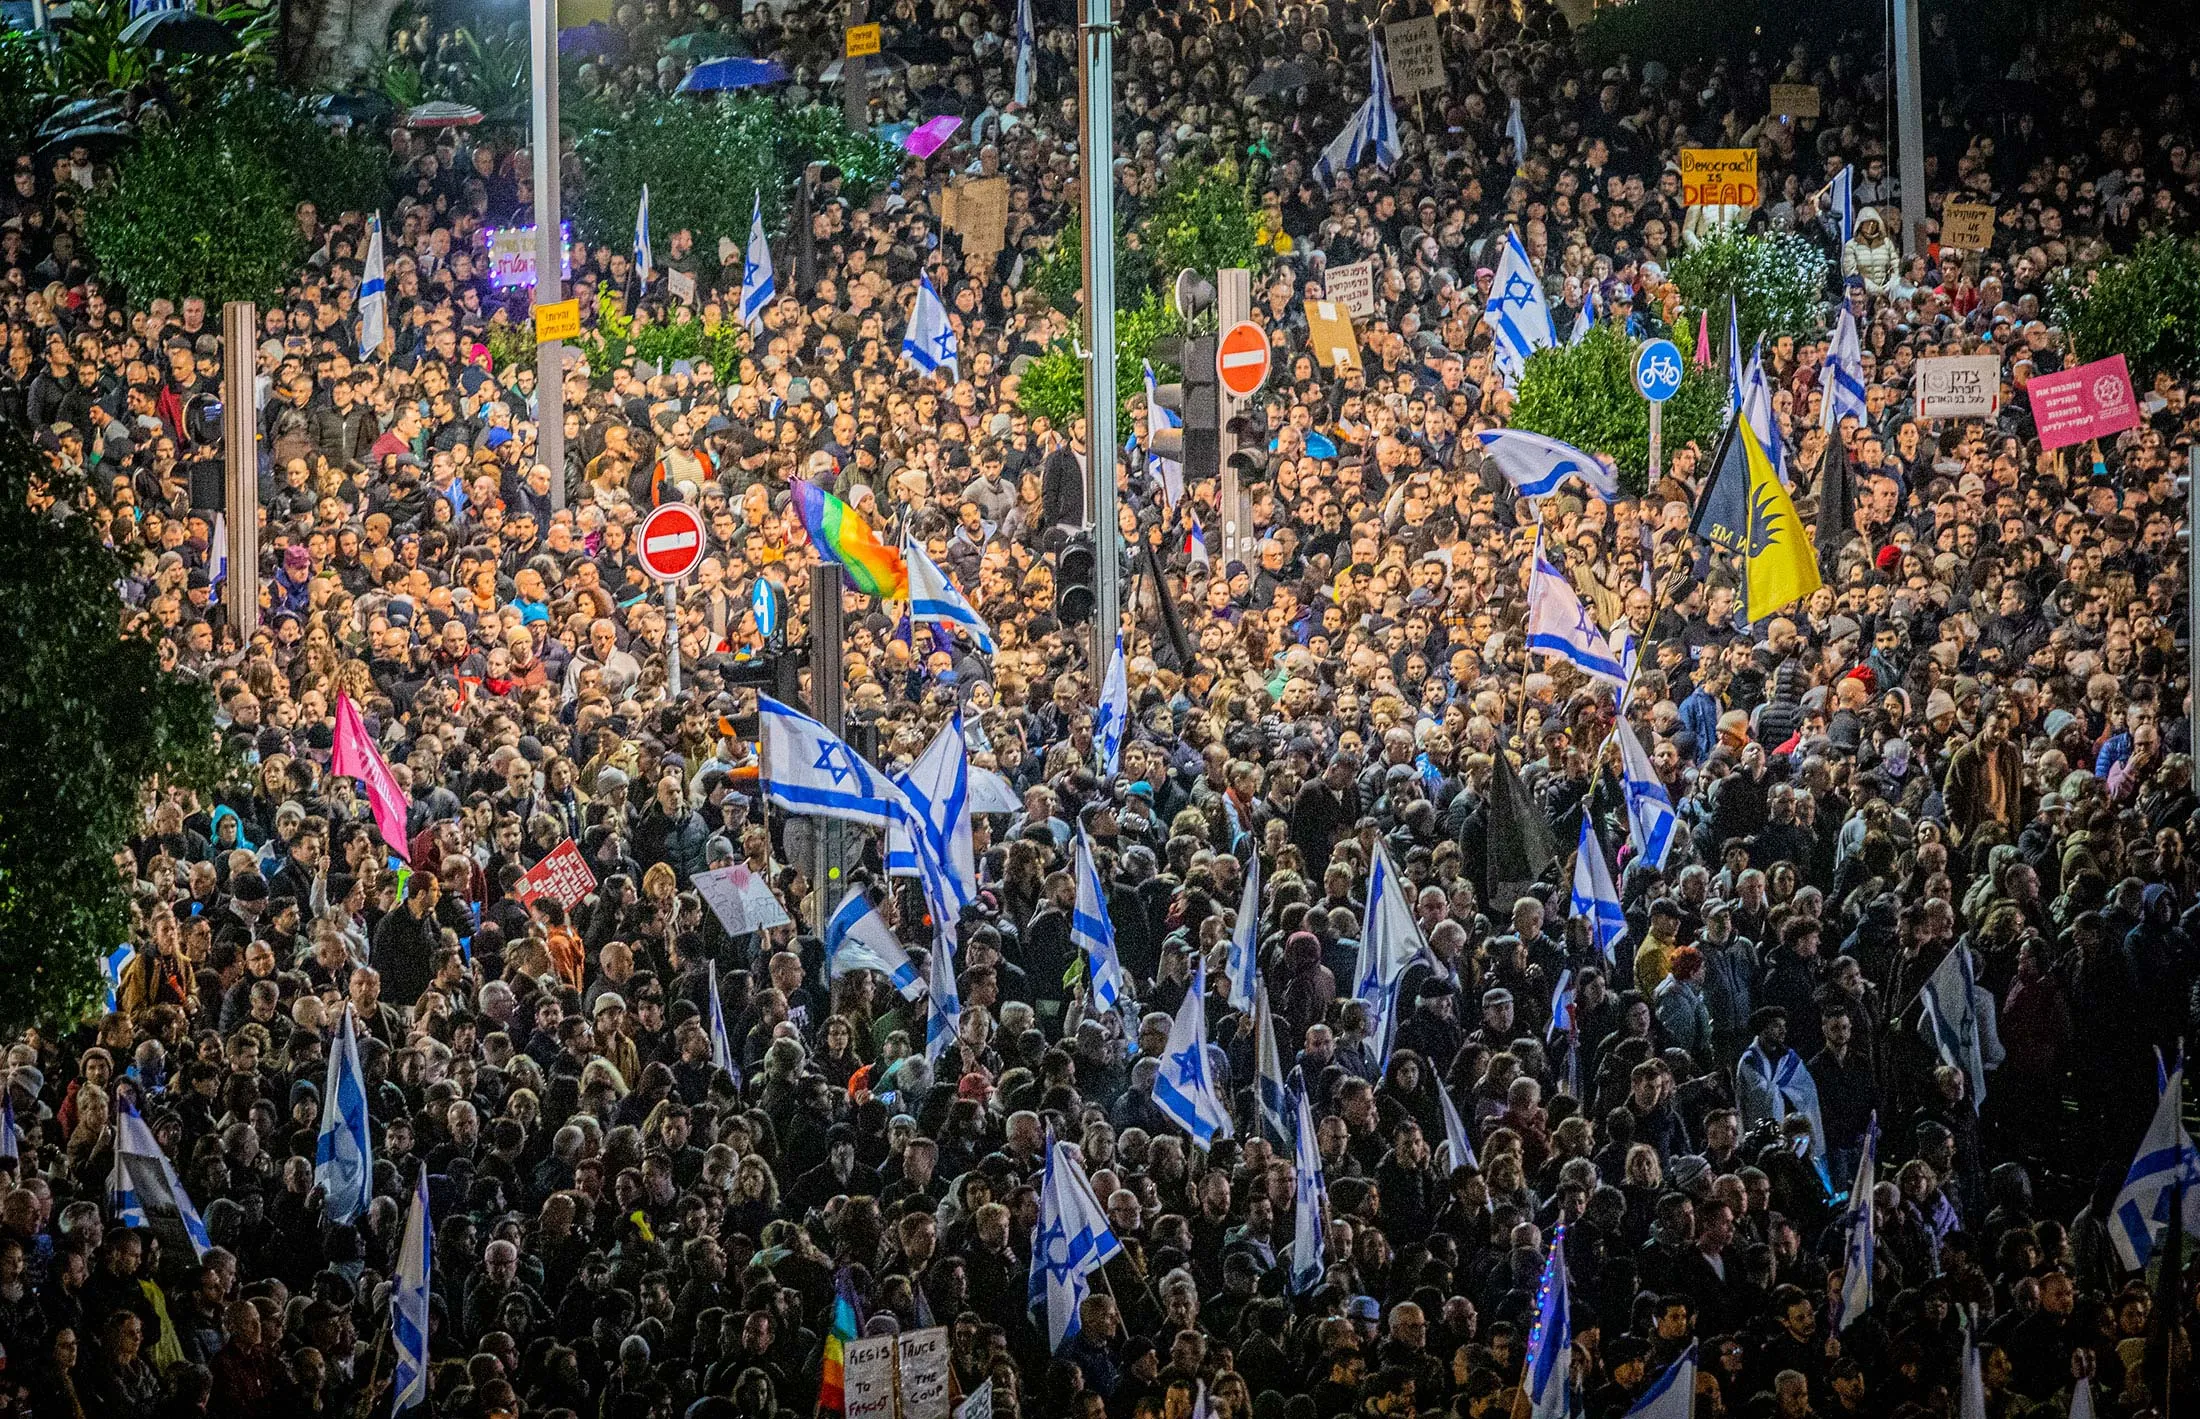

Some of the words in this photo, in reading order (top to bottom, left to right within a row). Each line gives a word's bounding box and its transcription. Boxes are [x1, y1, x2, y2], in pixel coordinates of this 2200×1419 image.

[1707, 173, 1722, 182] IS
[1684, 183, 1756, 205] DEAD
[1951, 369, 1980, 386] צדק
[1927, 394, 1953, 404] האדם
[2046, 394, 2078, 407] המדינה
[556, 854, 586, 898] וערבים
[567, 850, 594, 887] יהודים
[850, 1346, 890, 1365] RESIS
[915, 1372, 937, 1385] THE
[856, 1382, 871, 1394] TO
[911, 1385, 943, 1403] COUP
